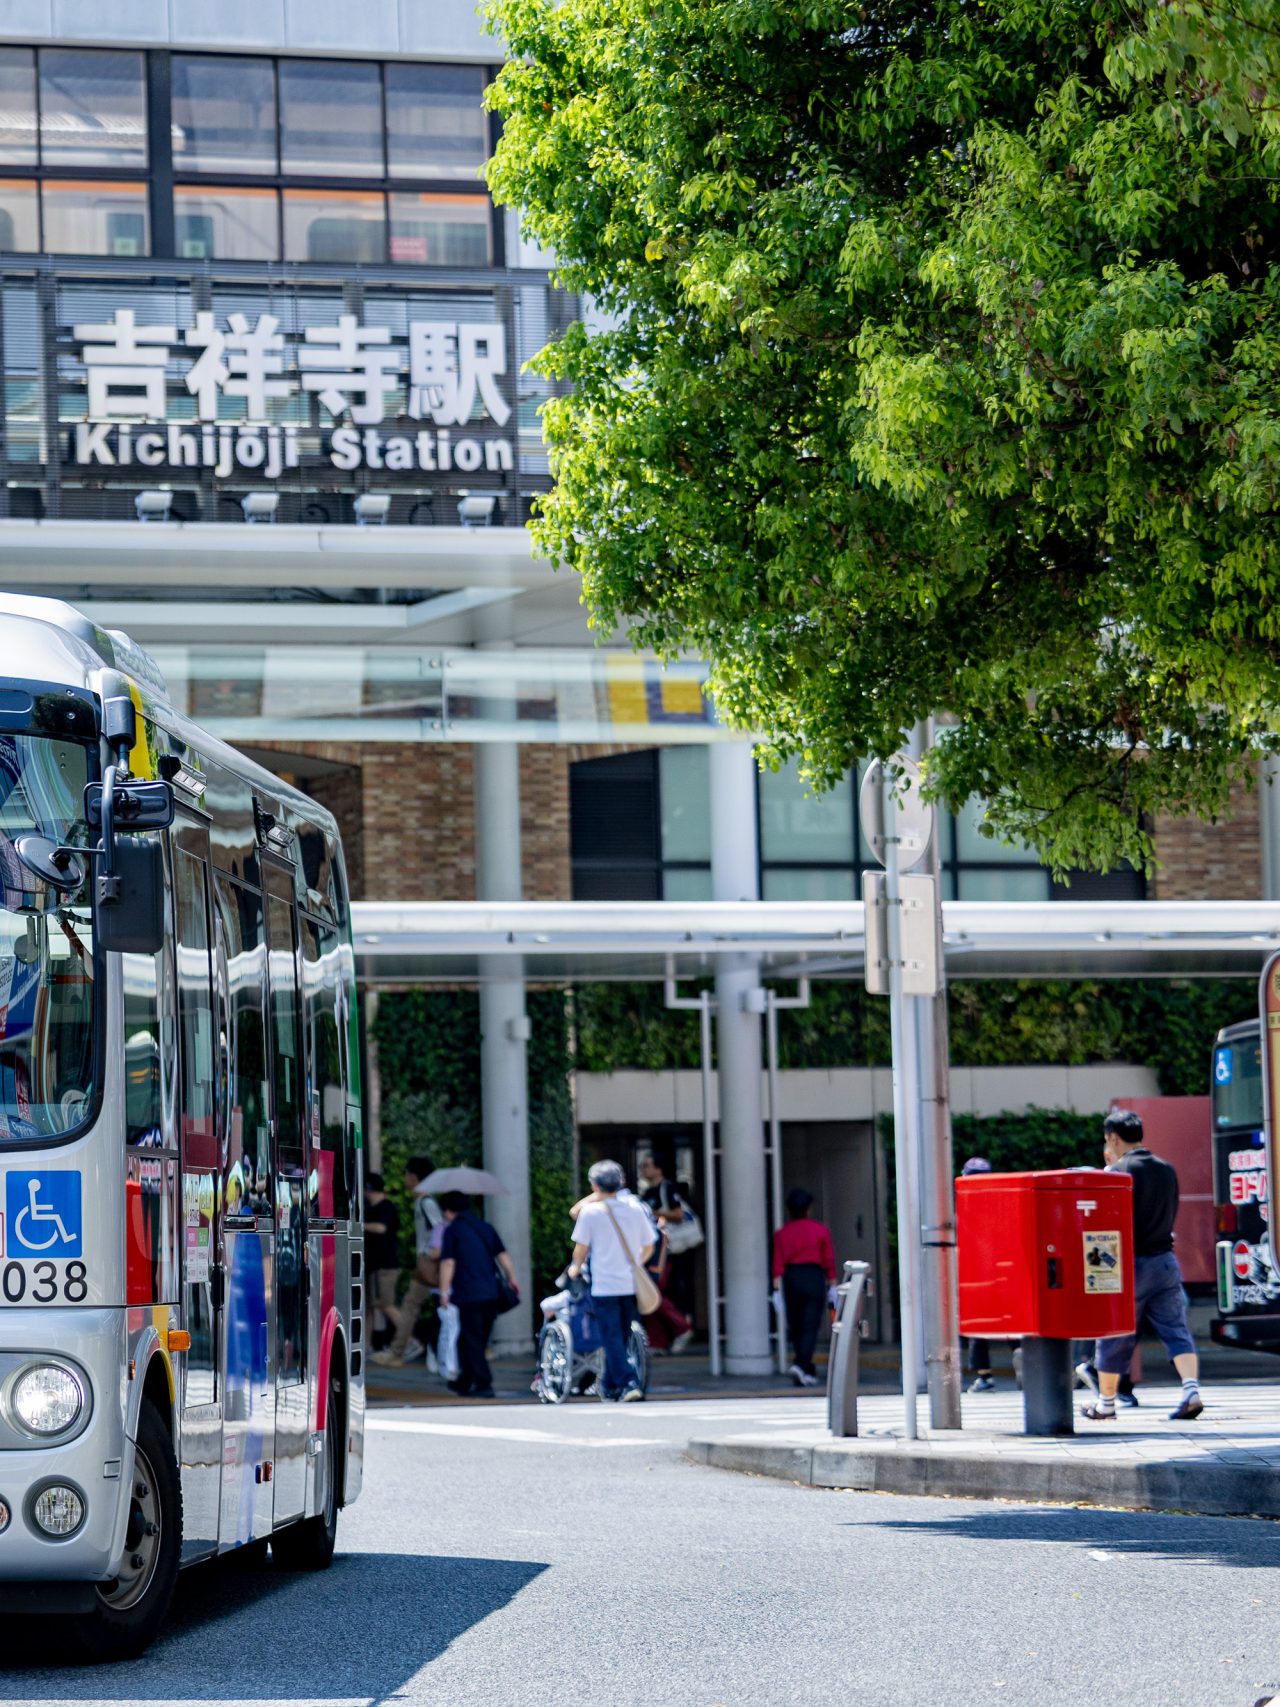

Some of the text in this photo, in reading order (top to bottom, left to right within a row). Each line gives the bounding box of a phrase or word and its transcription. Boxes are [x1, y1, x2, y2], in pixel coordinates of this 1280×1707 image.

[73, 309, 512, 427] 吉祥寺駅
[330, 428, 514, 472] Station
[2, 1261, 88, 1303] 038
